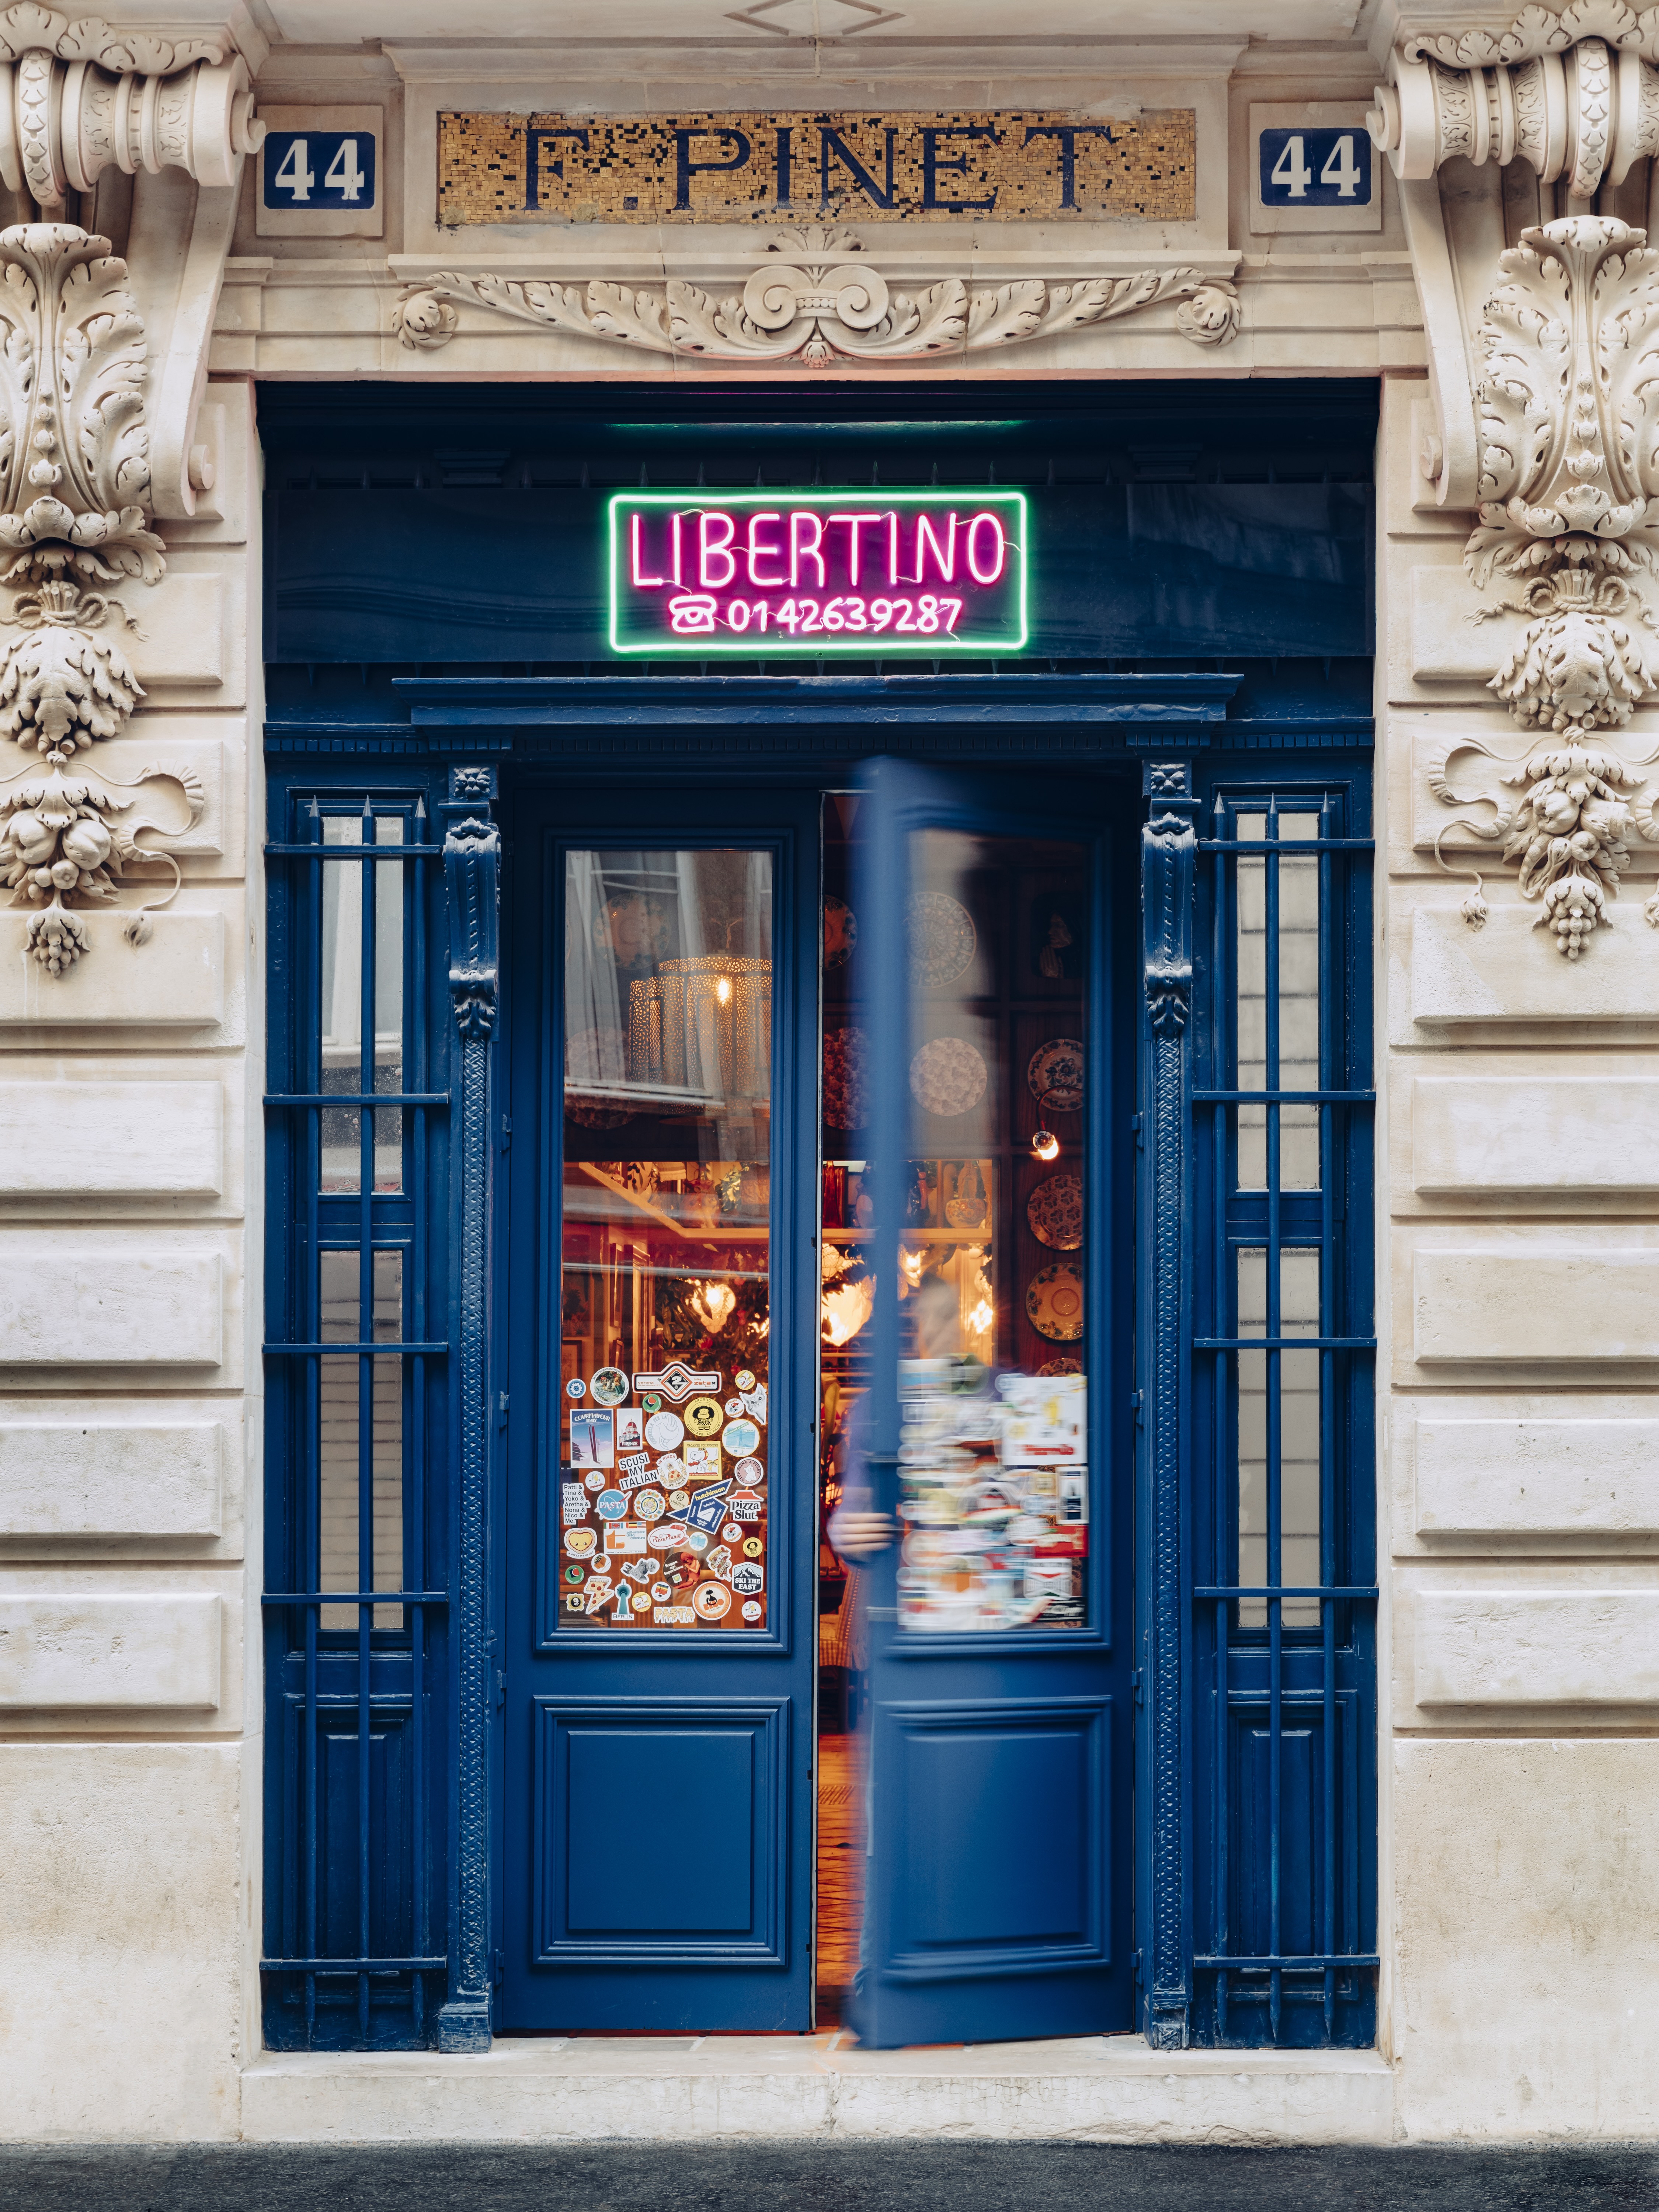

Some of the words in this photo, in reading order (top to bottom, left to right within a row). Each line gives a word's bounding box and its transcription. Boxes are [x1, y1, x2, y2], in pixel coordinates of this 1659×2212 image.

[275, 139, 364, 200] 44
[671, 126, 1112, 210] PINET
[1272, 135, 1360, 196] 44
[632, 512, 1004, 587] LIBERTINO
[728, 595, 961, 633] 0142639287
[594, 1395, 603, 1403] portano
[574, 1413, 611, 1422] COURMAYEUR
[687, 1424, 695, 1432] SONO
[620, 1454, 648, 1469] SCUSI
[738, 1460, 748, 1471] BEING
[629, 1465, 643, 1477] MY
[620, 1471, 657, 1489] ITALIAN
[675, 1477, 686, 1486] TRUST
[695, 1486, 726, 1501] hutchinson
[599, 1502, 625, 1510] PASTA
[732, 1500, 759, 1511] Pizza
[712, 1508, 722, 1528] schlauchreifen
[735, 1510, 756, 1519] Slut
[714, 1554, 723, 1568] PIZZA
[664, 1565, 684, 1575] Superissima
[655, 1608, 694, 1621] PASTA
